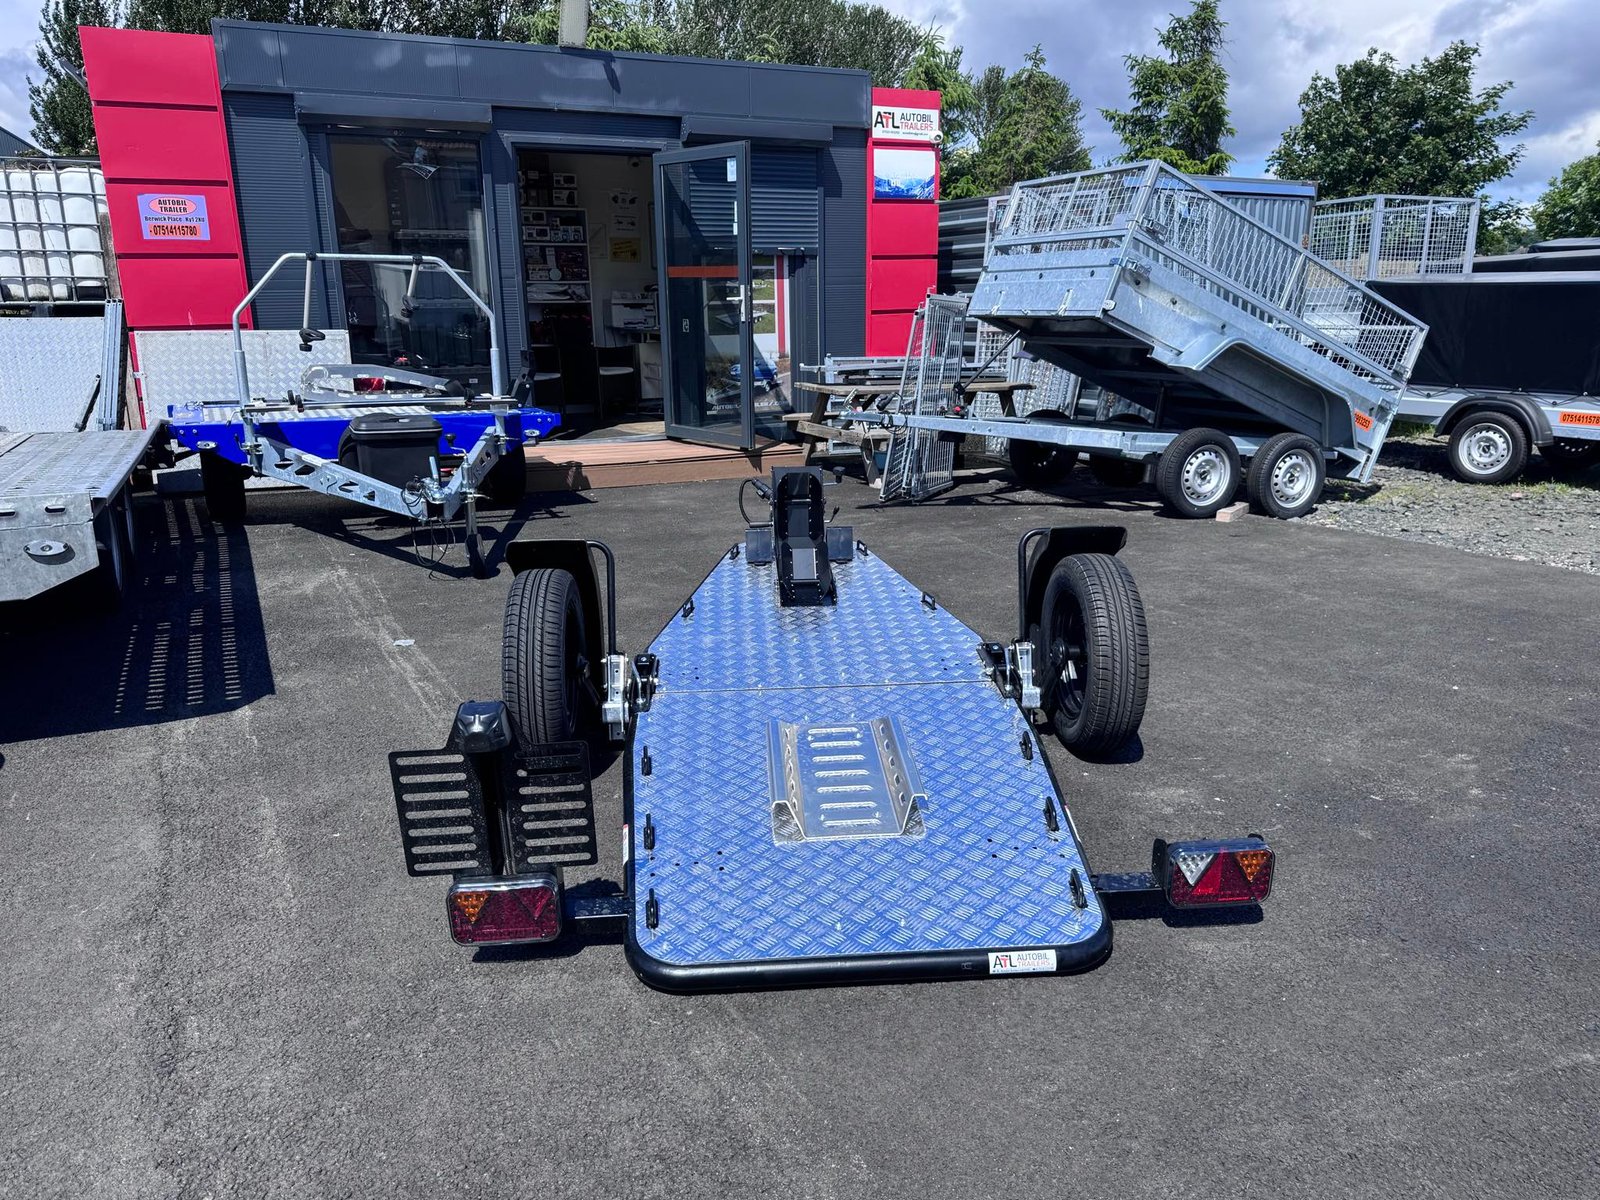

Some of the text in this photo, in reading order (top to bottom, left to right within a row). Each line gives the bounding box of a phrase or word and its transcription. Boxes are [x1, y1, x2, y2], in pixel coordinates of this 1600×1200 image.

[874, 111, 900, 129] ATL
[900, 112, 933, 123] AUTOBIL
[900, 121, 934, 131] TRAILERS
[153, 225, 197, 236] 07514115780
[1562, 413, 1600, 424] 0751411578
[993, 954, 1017, 969] ATL
[1017, 952, 1049, 961] AUTOBIL
[1017, 959, 1051, 967] TRAILERS
